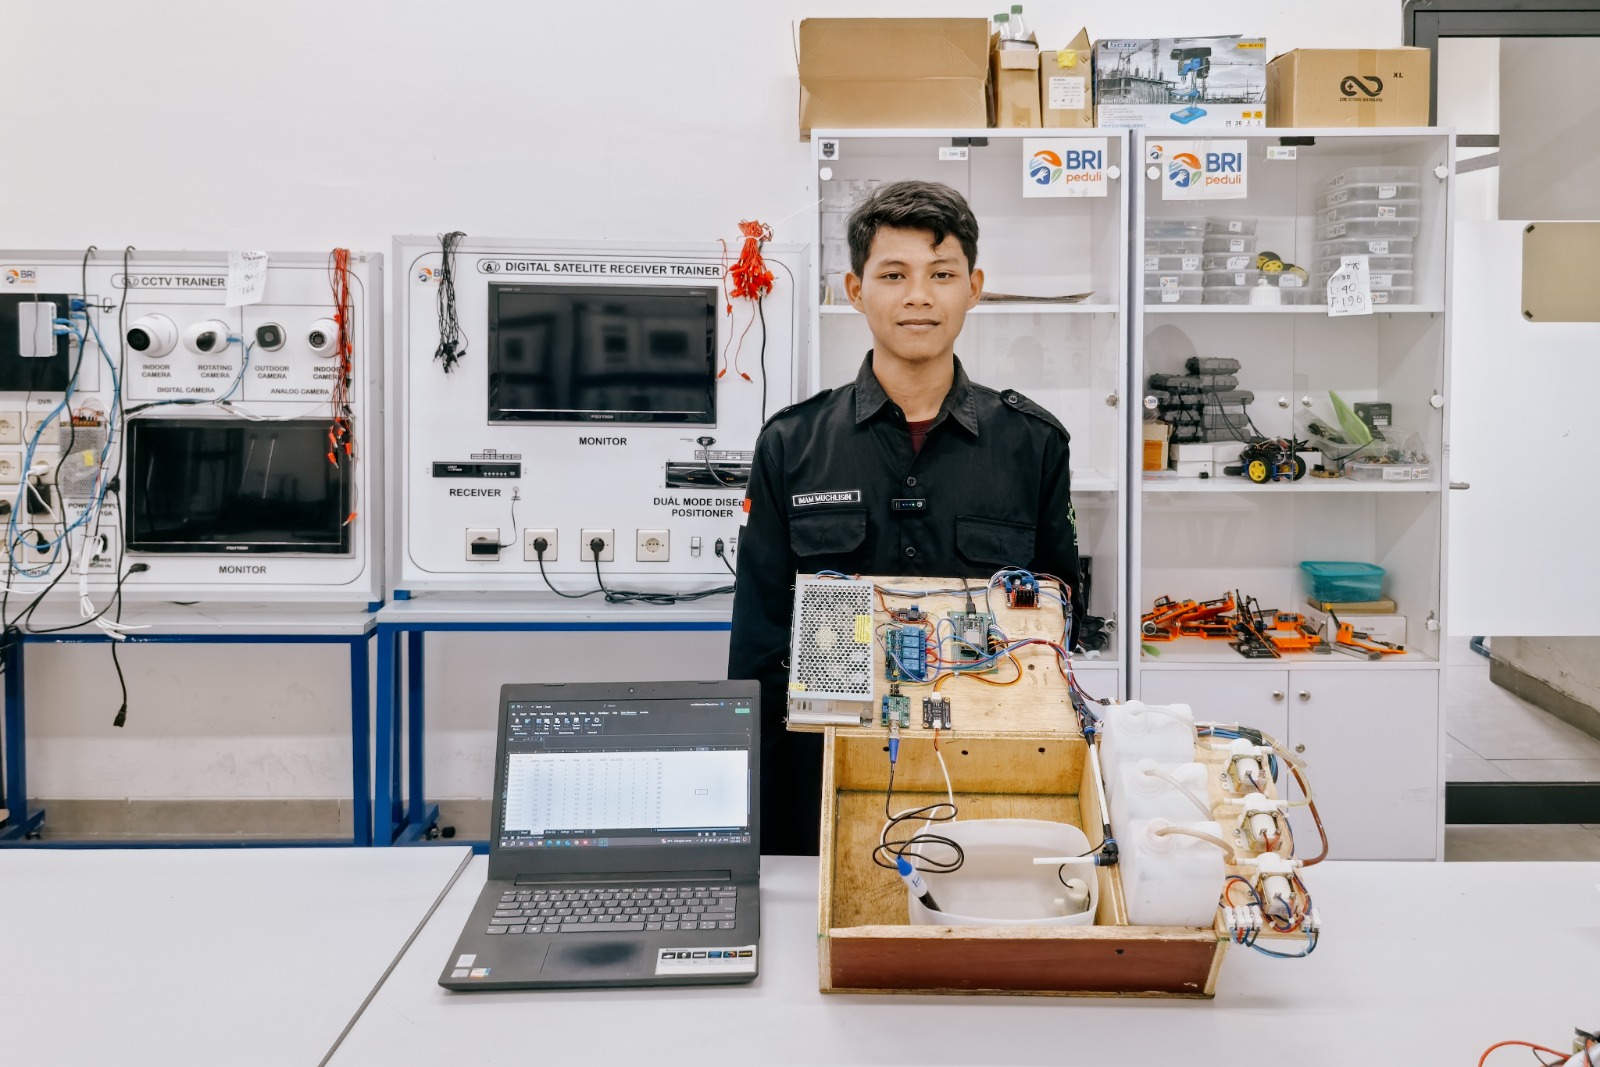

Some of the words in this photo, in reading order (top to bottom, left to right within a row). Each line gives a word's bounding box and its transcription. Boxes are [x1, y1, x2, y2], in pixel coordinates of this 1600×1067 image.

[1066, 149, 1102, 170] BRI
[1205, 152, 1242, 172] BRI
[1066, 171, 1102, 184] peduli
[1205, 174, 1242, 186] peduli
[20, 270, 35, 278] BRI
[505, 262, 551, 272] DIGITAL
[553, 263, 607, 273] SATELITE
[610, 264, 667, 275] RECEIVER
[670, 266, 720, 276] TRAINER
[141, 277, 172, 287] CCTV
[174, 277, 226, 287] TRAINER
[1341, 282, 1357, 295] 40
[1342, 294, 1363, 308] 196
[579, 437, 627, 446] MONITOR
[449, 488, 502, 497] RECEIVER
[653, 497, 681, 506] DUAL
[683, 498, 713, 506] MODE
[671, 509, 734, 518] POSITIONER
[218, 565, 267, 574] MONITOR
